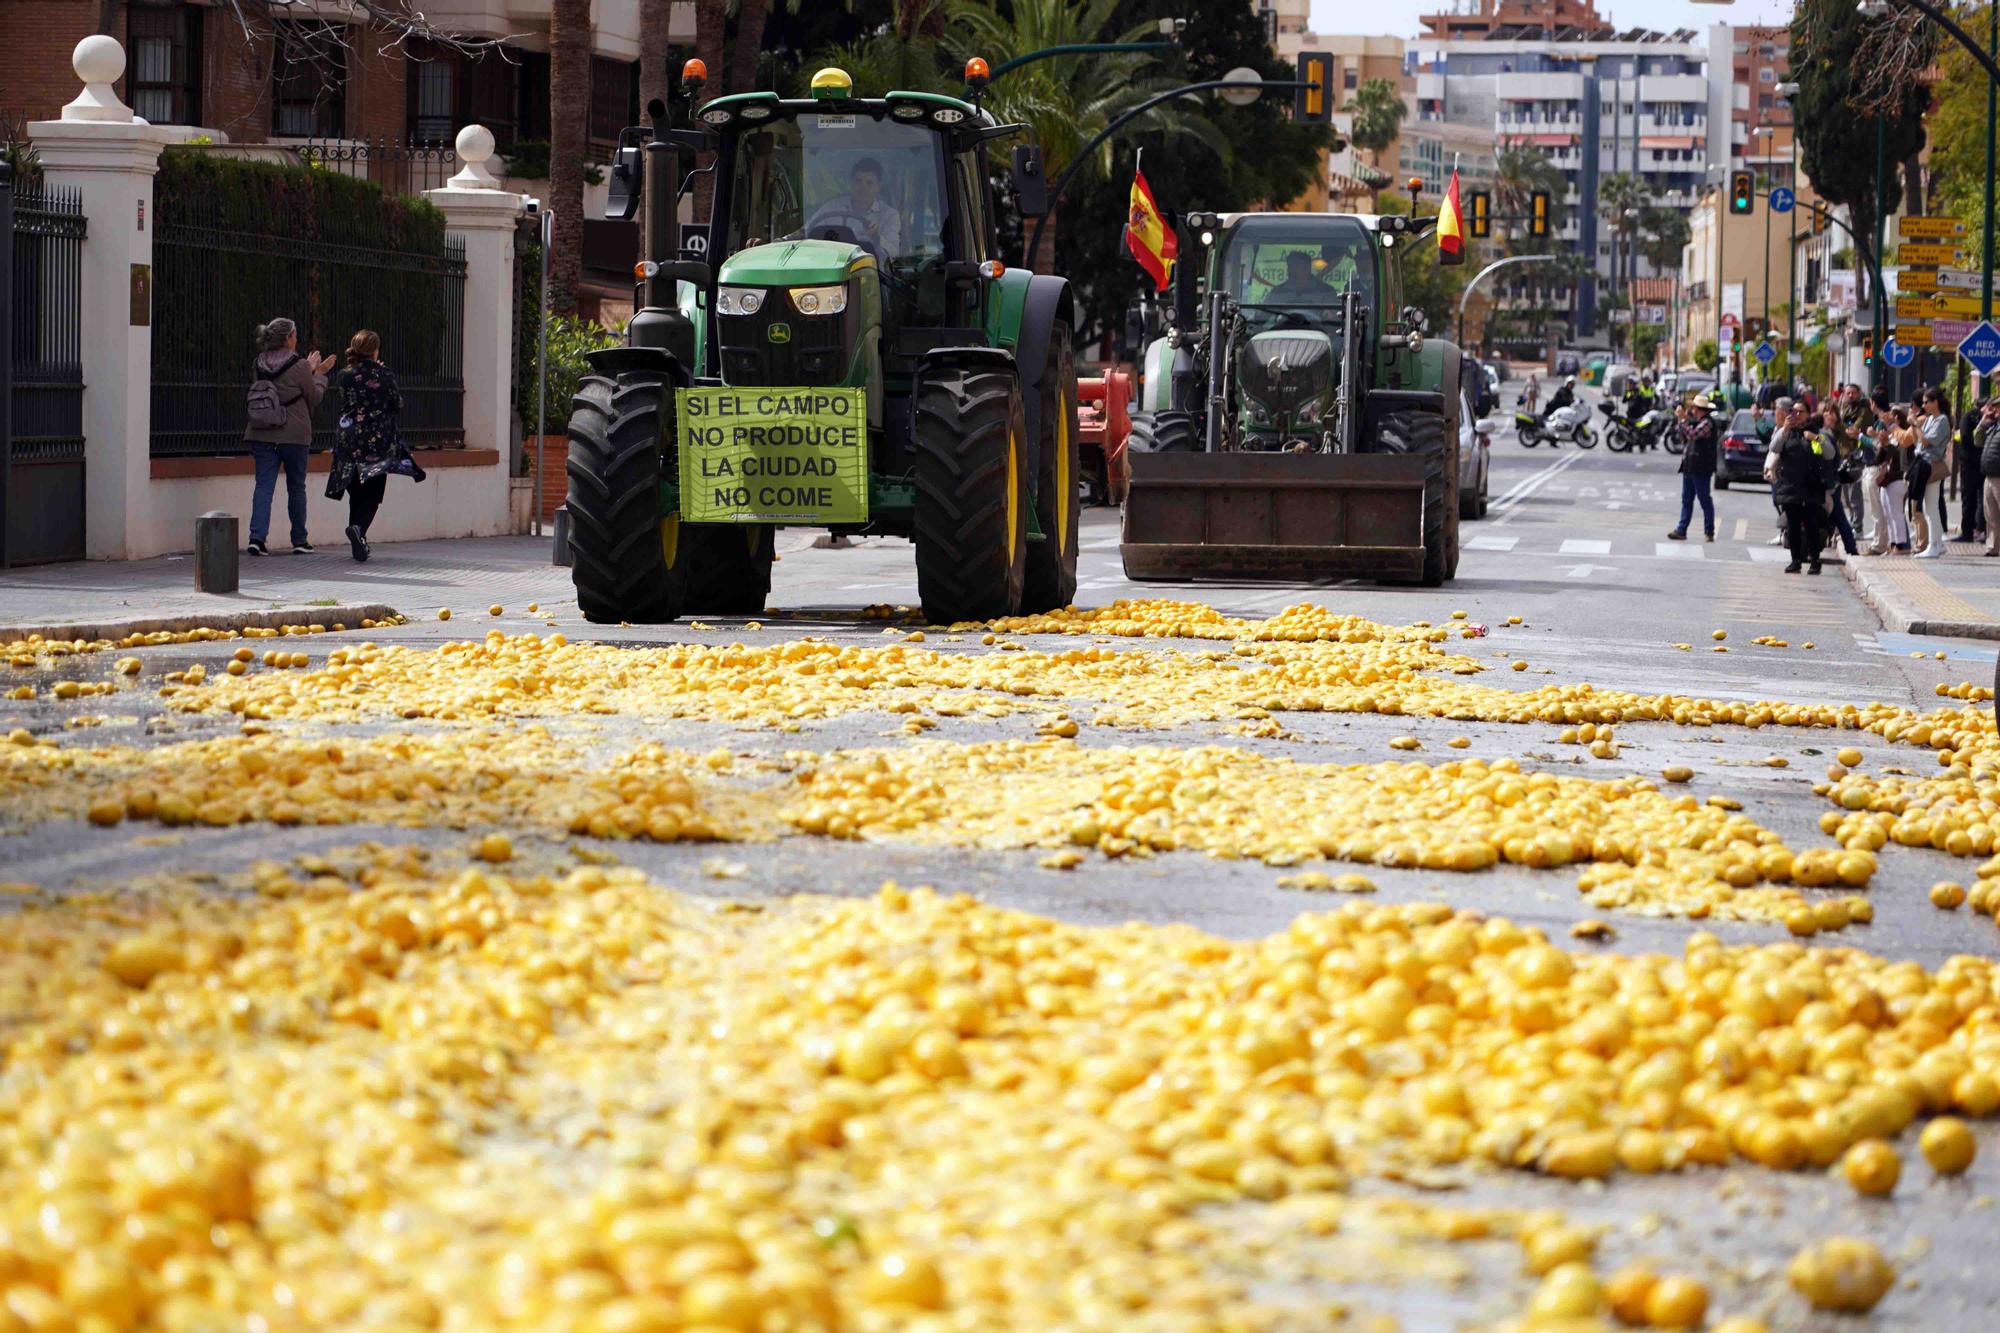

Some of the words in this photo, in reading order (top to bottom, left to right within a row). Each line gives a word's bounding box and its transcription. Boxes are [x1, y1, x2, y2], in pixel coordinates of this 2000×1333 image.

[1899, 280, 1937, 288] Californi
[1976, 340, 1995, 348] RED
[687, 396, 709, 417] SI
[719, 396, 748, 416] EL
[756, 395, 849, 417] CAMPO
[688, 427, 725, 447] NO
[732, 426, 857, 447] PRODUCE
[702, 457, 735, 477] LA
[741, 457, 837, 477] CIUDAD
[714, 487, 751, 507] NO
[759, 487, 833, 507] COME
